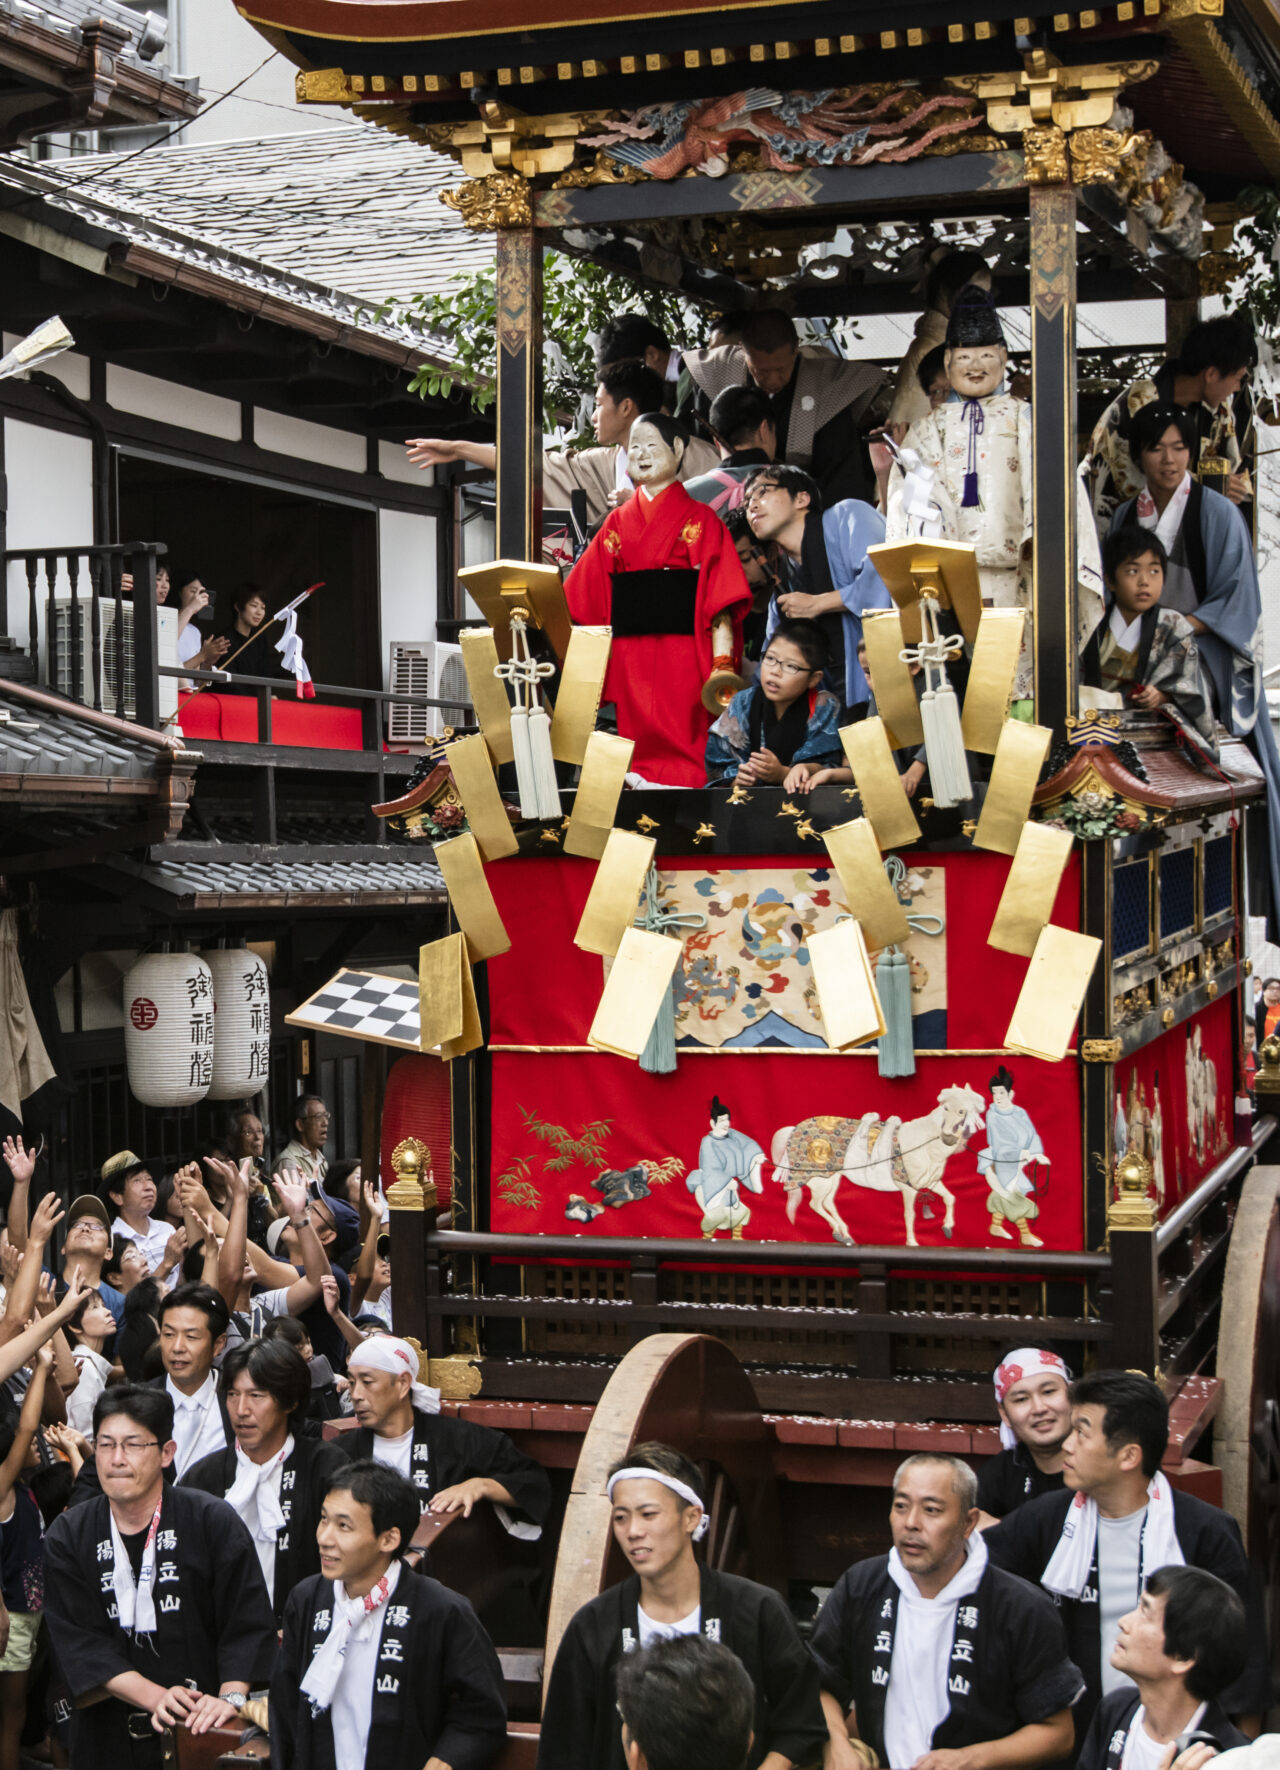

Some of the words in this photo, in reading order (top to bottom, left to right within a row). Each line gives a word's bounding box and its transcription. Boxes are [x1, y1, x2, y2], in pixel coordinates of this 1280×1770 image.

[96, 1539, 120, 1619] 湯立山
[157, 1529, 181, 1613] 湯立山
[376, 1605, 412, 1693] 湯立山
[948, 1606, 979, 1695] 湯立山
